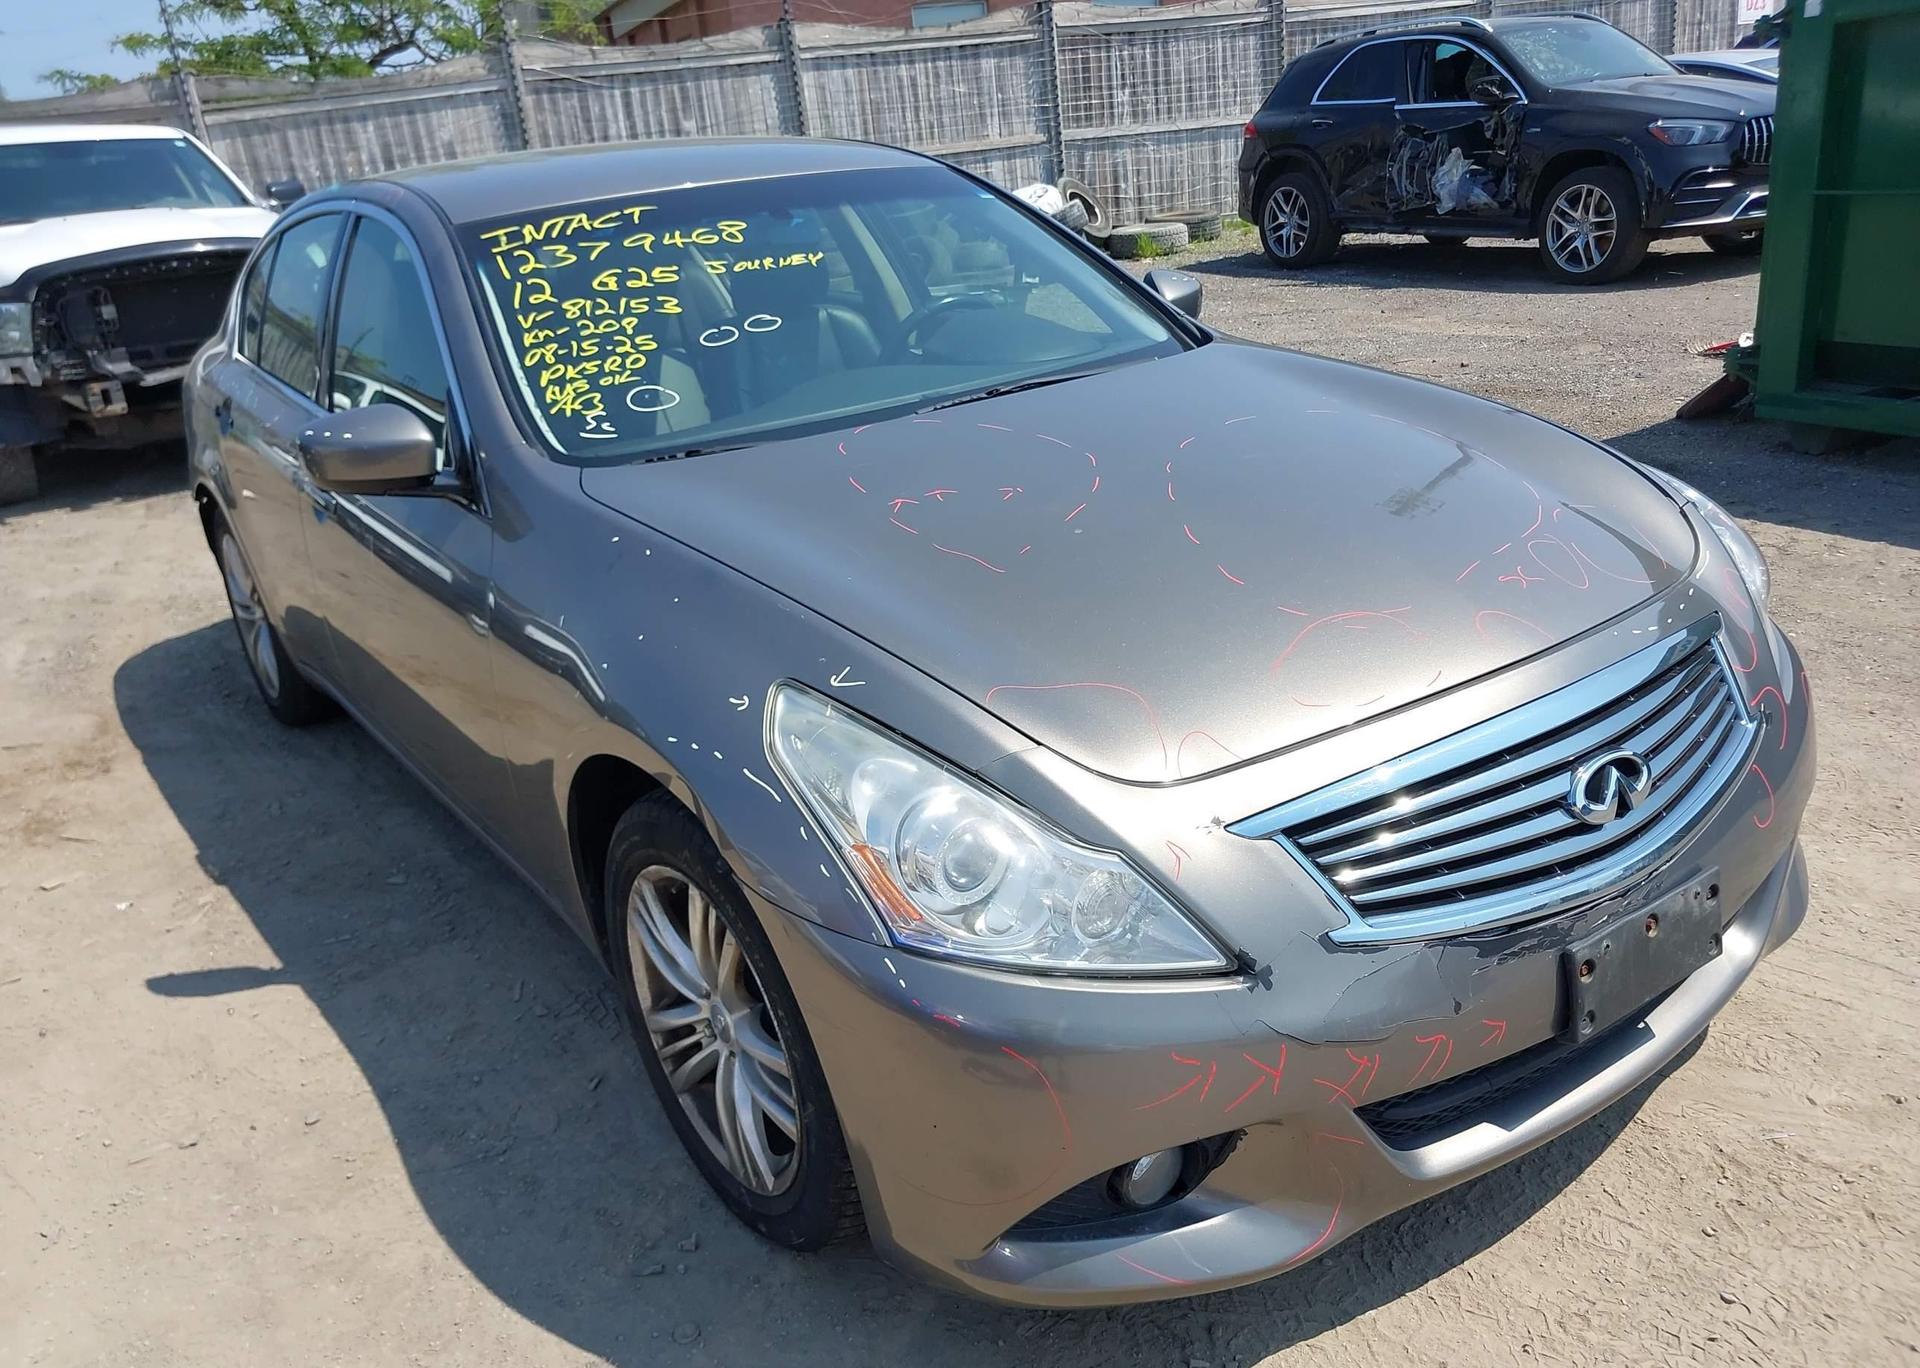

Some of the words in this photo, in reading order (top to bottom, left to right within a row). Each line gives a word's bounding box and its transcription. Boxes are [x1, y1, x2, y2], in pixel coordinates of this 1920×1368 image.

[480, 205, 659, 253] INTACT
[495, 220, 749, 281] 12379468
[513, 277, 559, 310] 12
[591, 265, 681, 292] G25
[703, 251, 825, 275] JOURNEY
